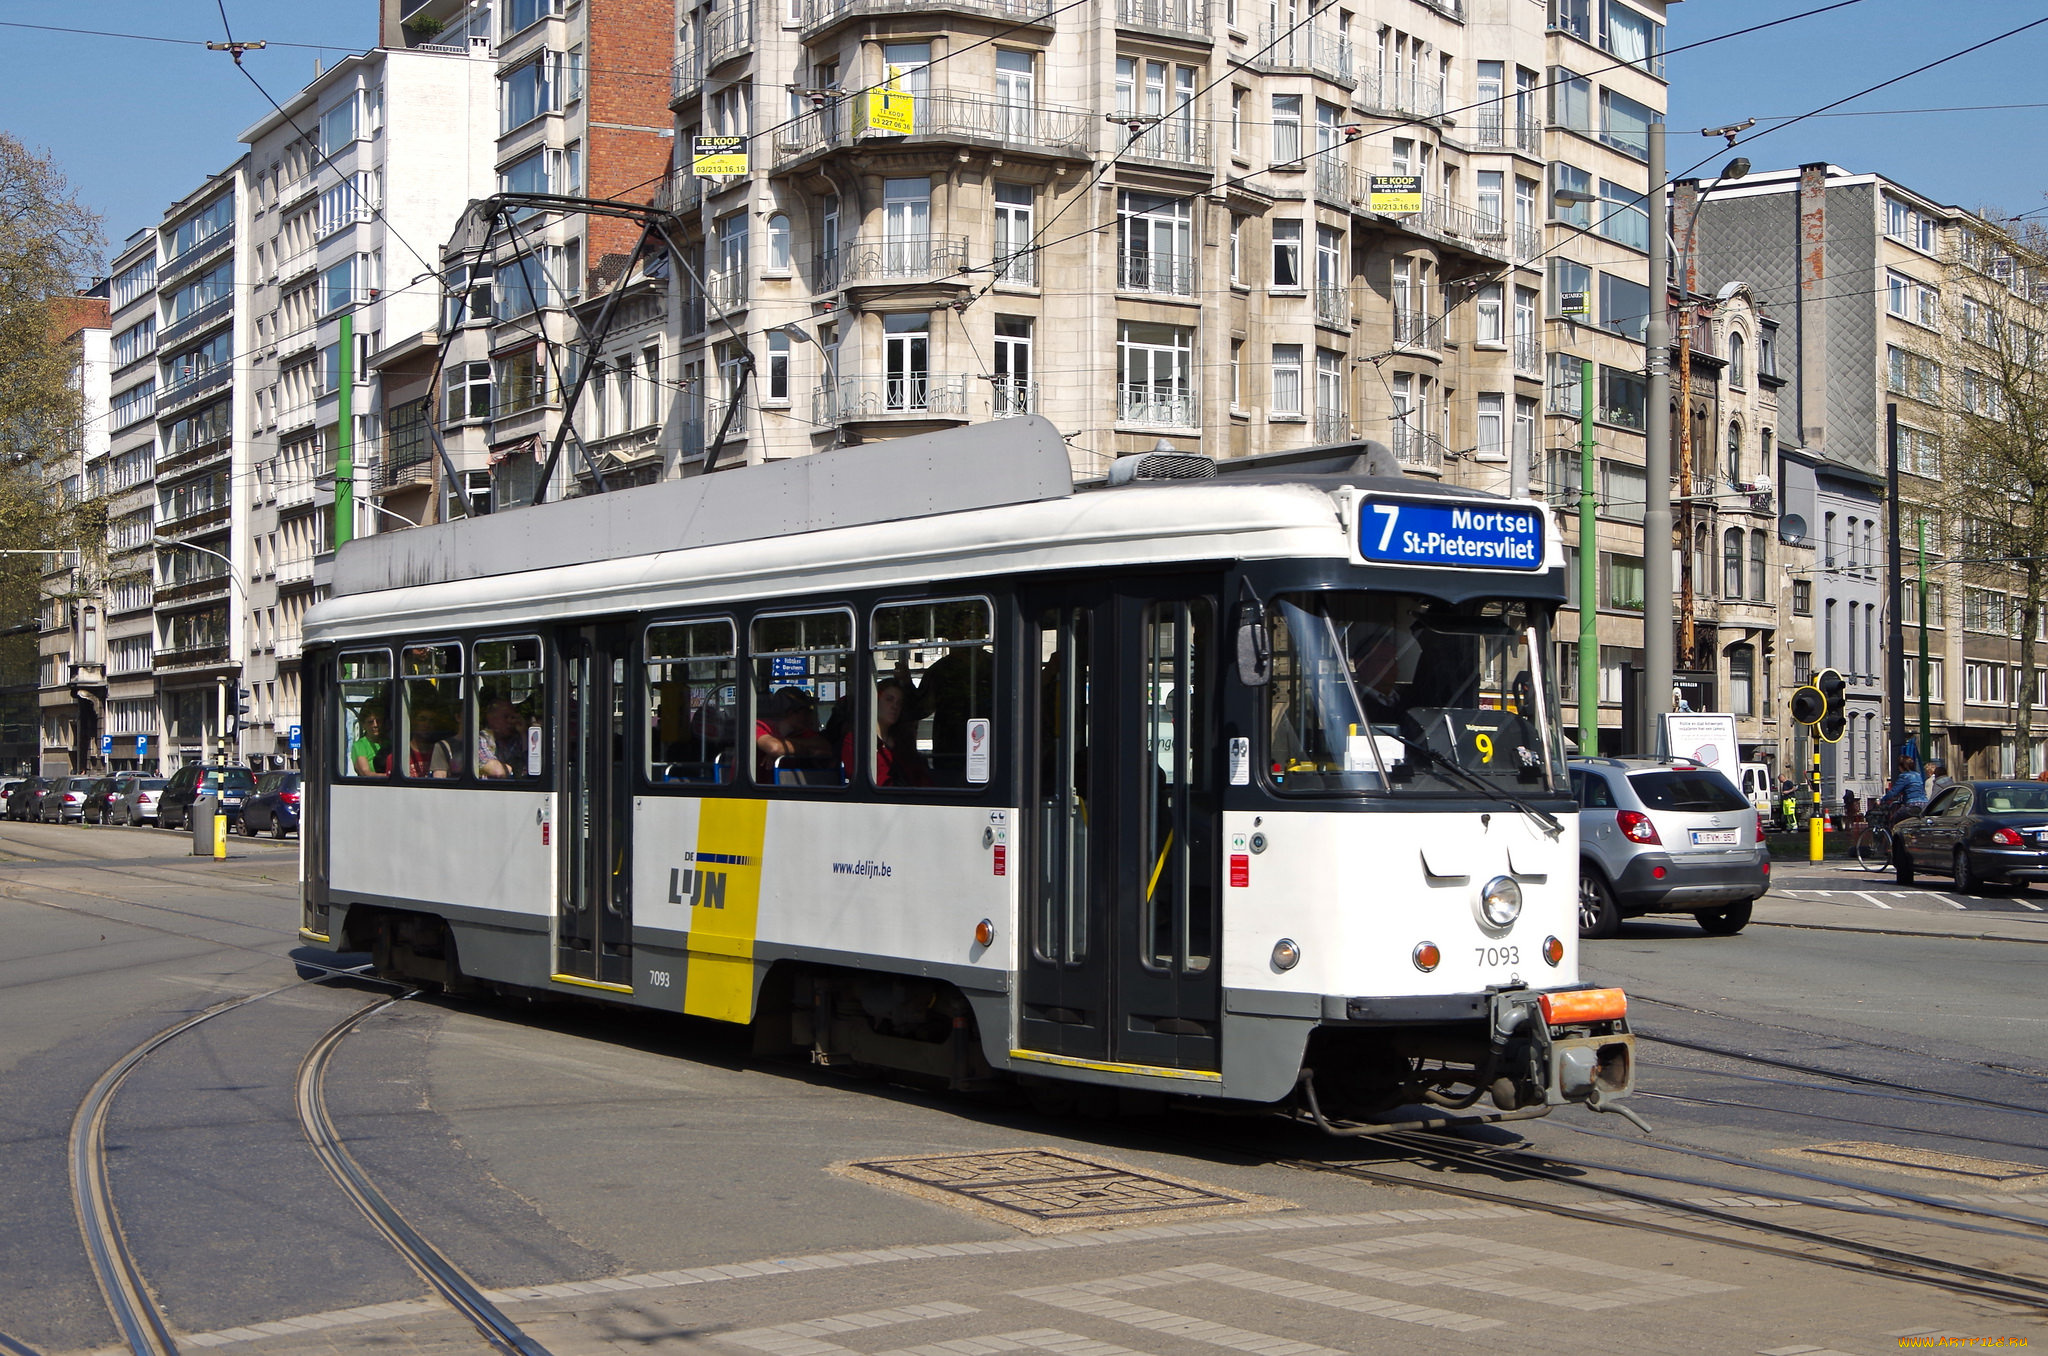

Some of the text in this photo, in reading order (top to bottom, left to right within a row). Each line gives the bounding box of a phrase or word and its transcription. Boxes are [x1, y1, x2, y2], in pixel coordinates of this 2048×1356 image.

[700, 137, 740, 146] TE KOOP
[696, 165, 746, 173] 03/213.16.19
[1376, 177, 1415, 185] TE KOOP
[1372, 203, 1420, 211] 03/213.16.19
[1372, 504, 1400, 552] 7
[1452, 507, 1534, 534] Mortsel
[1403, 530, 1535, 560] St.-Pietersvliet
[103, 736, 111, 748] P
[138, 736, 147, 748] P
[291, 727, 301, 741] P
[1475, 733, 1494, 763] 9
[684, 851, 695, 861] DE
[833, 860, 892, 879] www.delijn.be
[668, 868, 727, 909] LIJN
[1475, 945, 1520, 967] 7093
[649, 969, 670, 988] 7093
